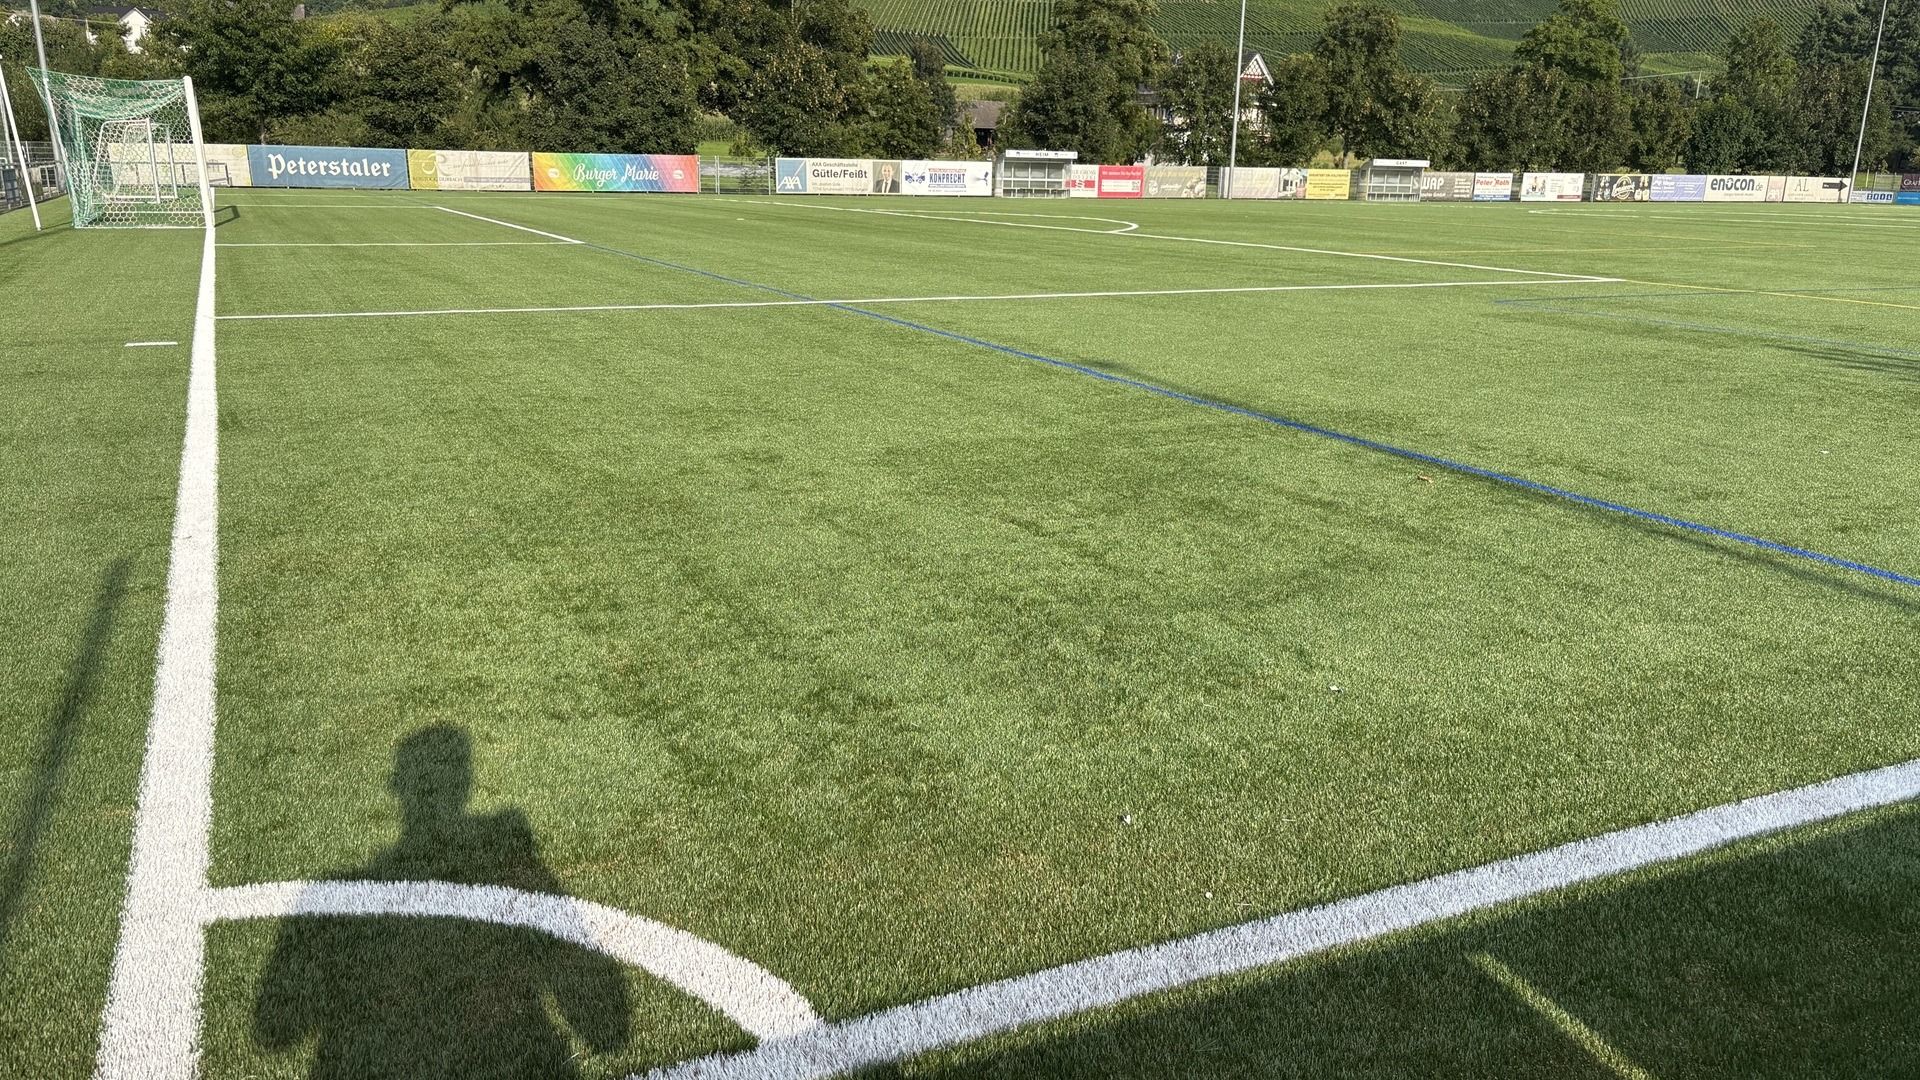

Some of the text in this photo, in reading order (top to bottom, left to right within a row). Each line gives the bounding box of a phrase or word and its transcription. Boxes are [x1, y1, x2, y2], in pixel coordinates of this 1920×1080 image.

[267, 153, 391, 179] Peterstaler
[573, 164, 659, 187] Burger Marie
[812, 169, 867, 178] Gütle/Feißt
[929, 173, 965, 183] KONPRECHT
[778, 176, 802, 190] AXA
